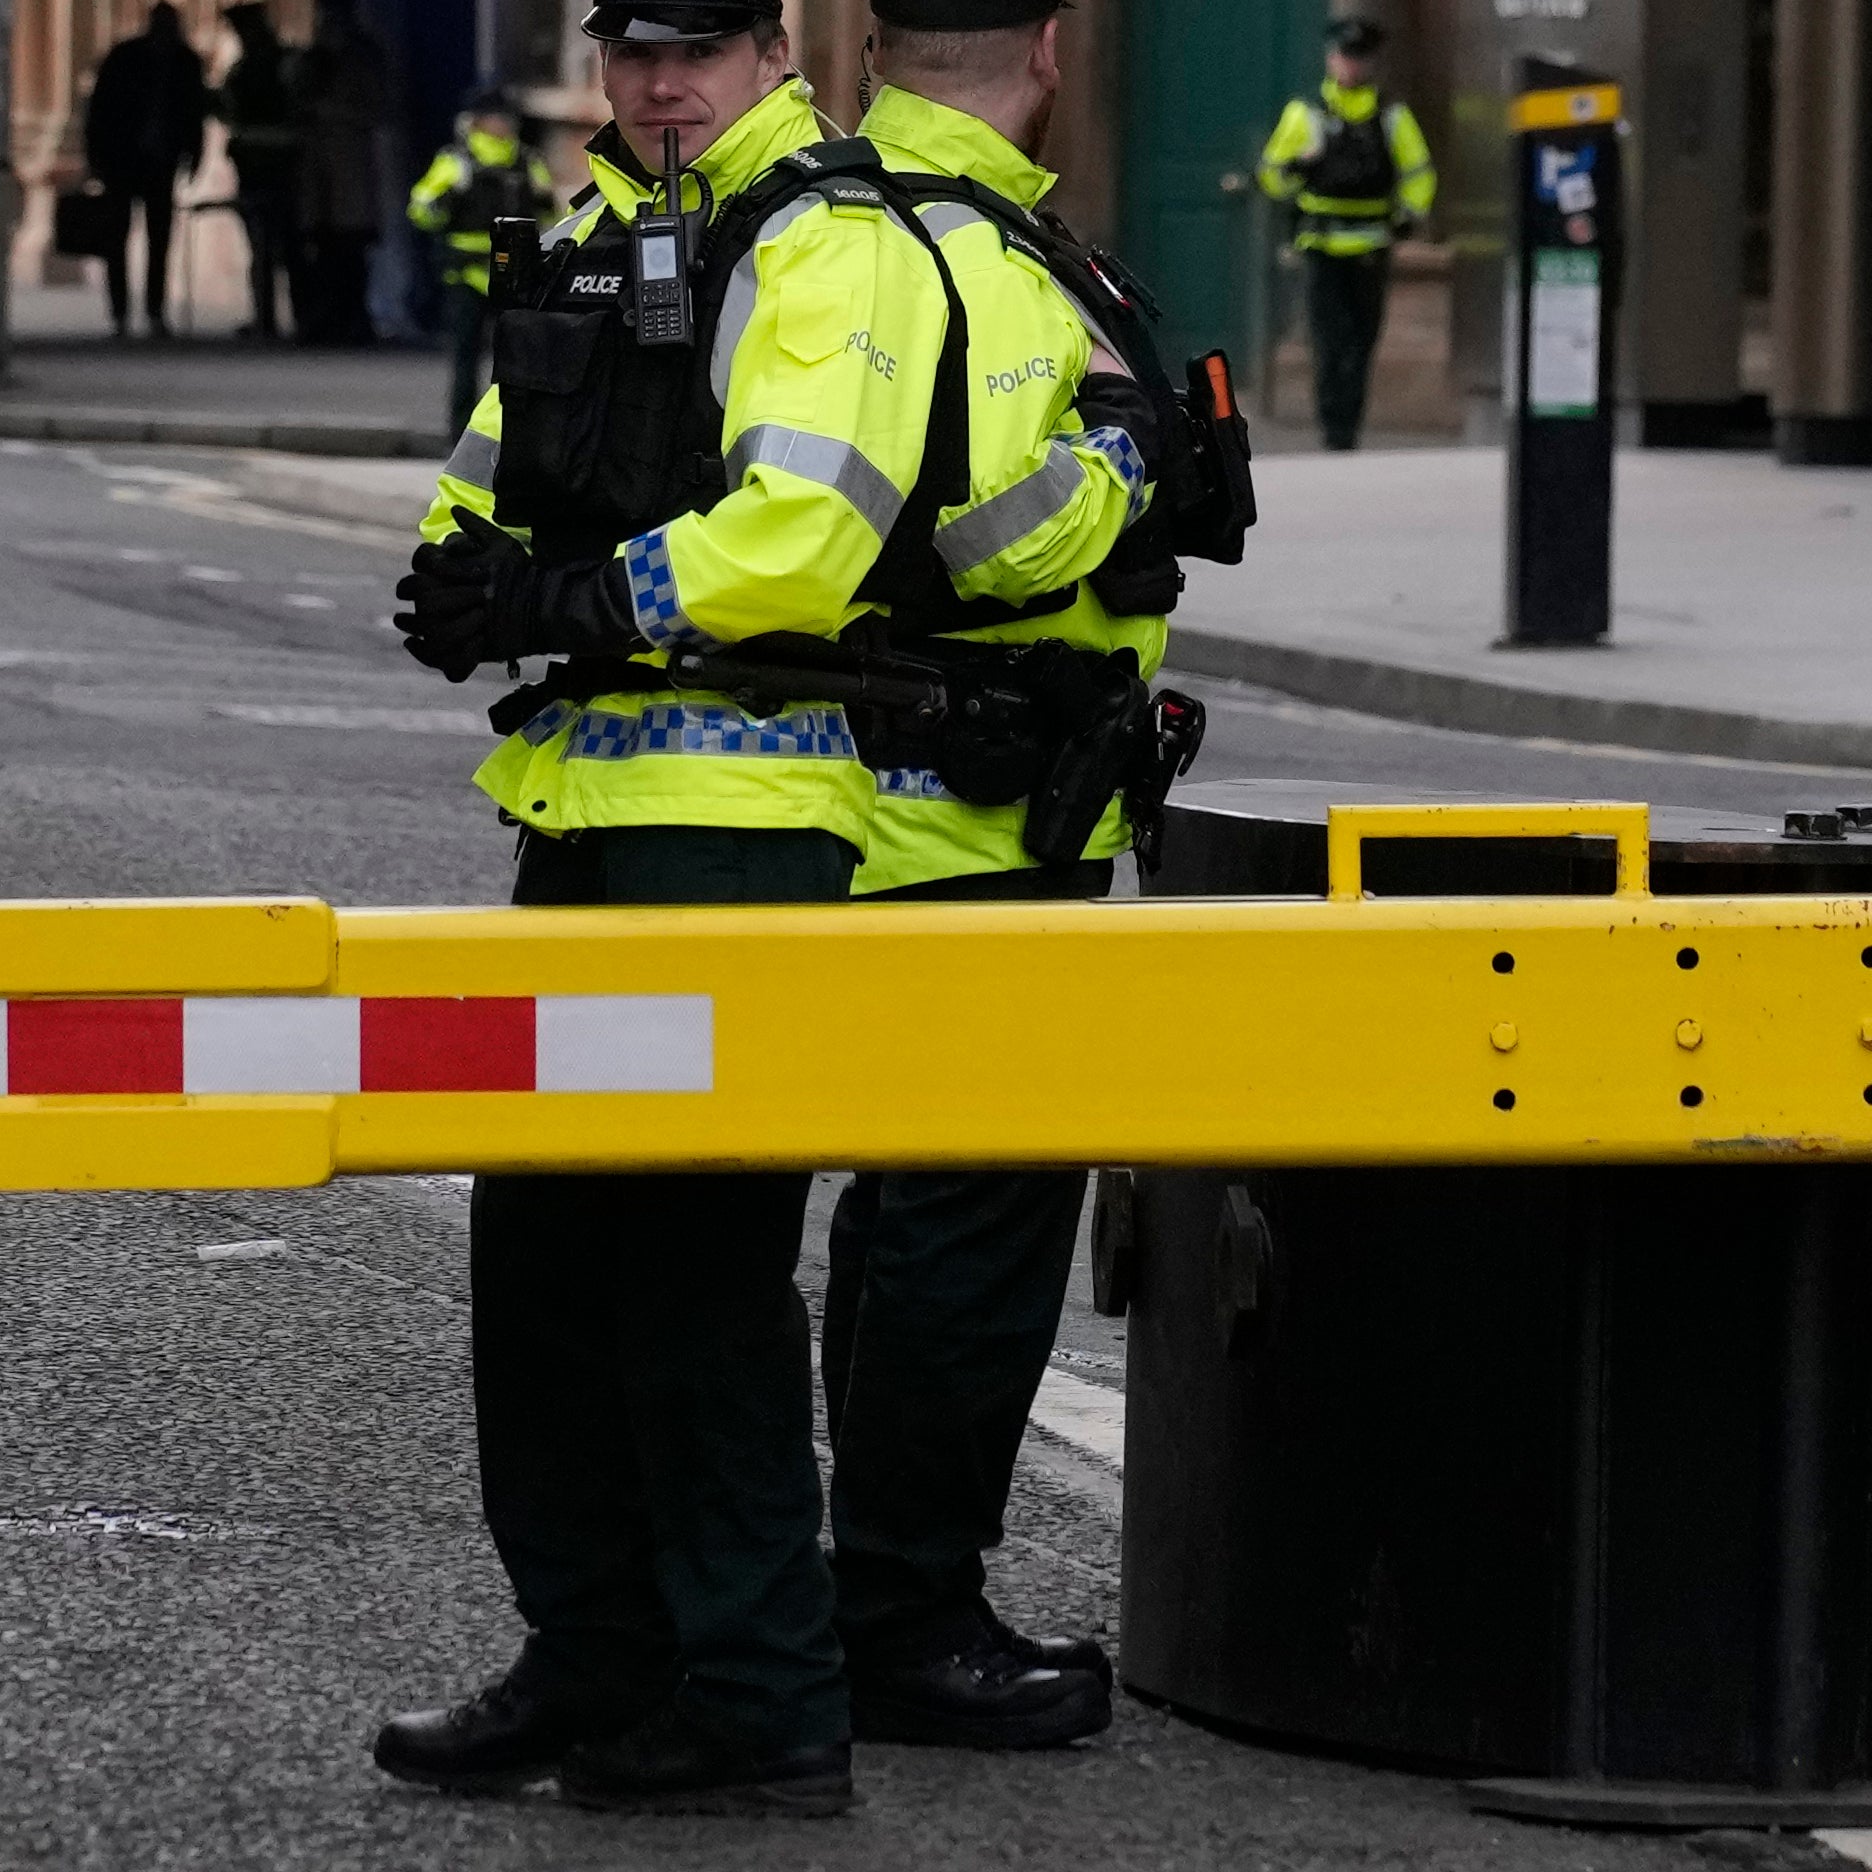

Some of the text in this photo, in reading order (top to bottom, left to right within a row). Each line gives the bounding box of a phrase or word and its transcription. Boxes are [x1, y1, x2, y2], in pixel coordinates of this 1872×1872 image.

[833, 188, 880, 202] 16005
[569, 275, 623, 294] POLICE
[986, 357, 1057, 397] POLICE
